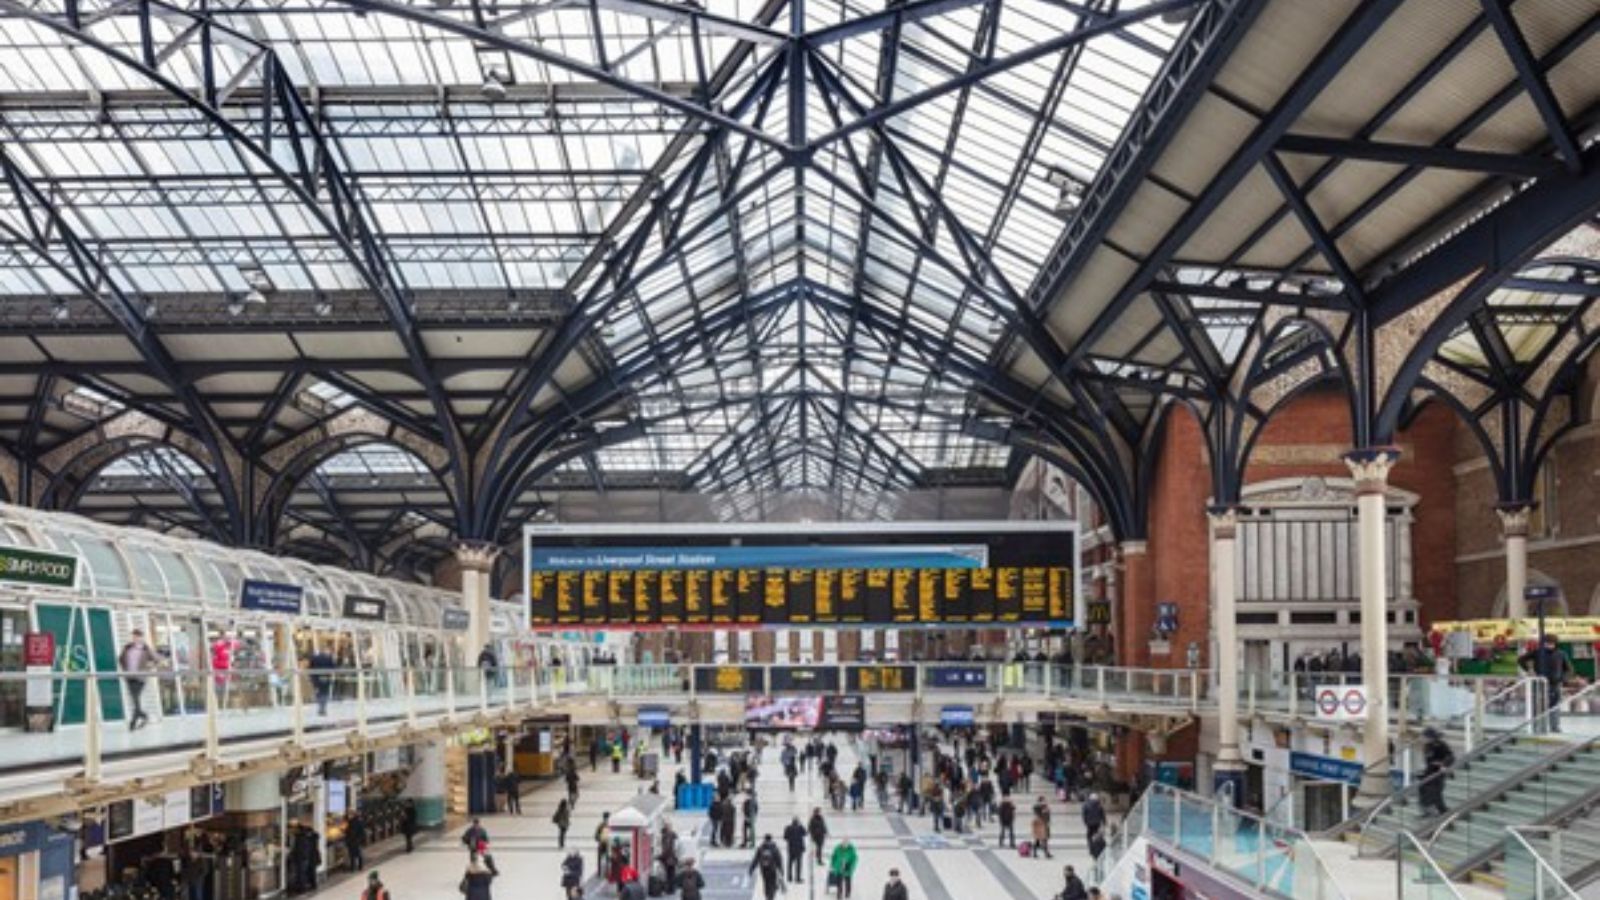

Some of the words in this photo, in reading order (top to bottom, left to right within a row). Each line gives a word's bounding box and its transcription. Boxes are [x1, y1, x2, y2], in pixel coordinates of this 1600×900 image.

[549, 556, 584, 567] Welcome
[597, 555, 644, 569] Liverpool
[645, 554, 675, 566] Street
[677, 554, 717, 566] Station
